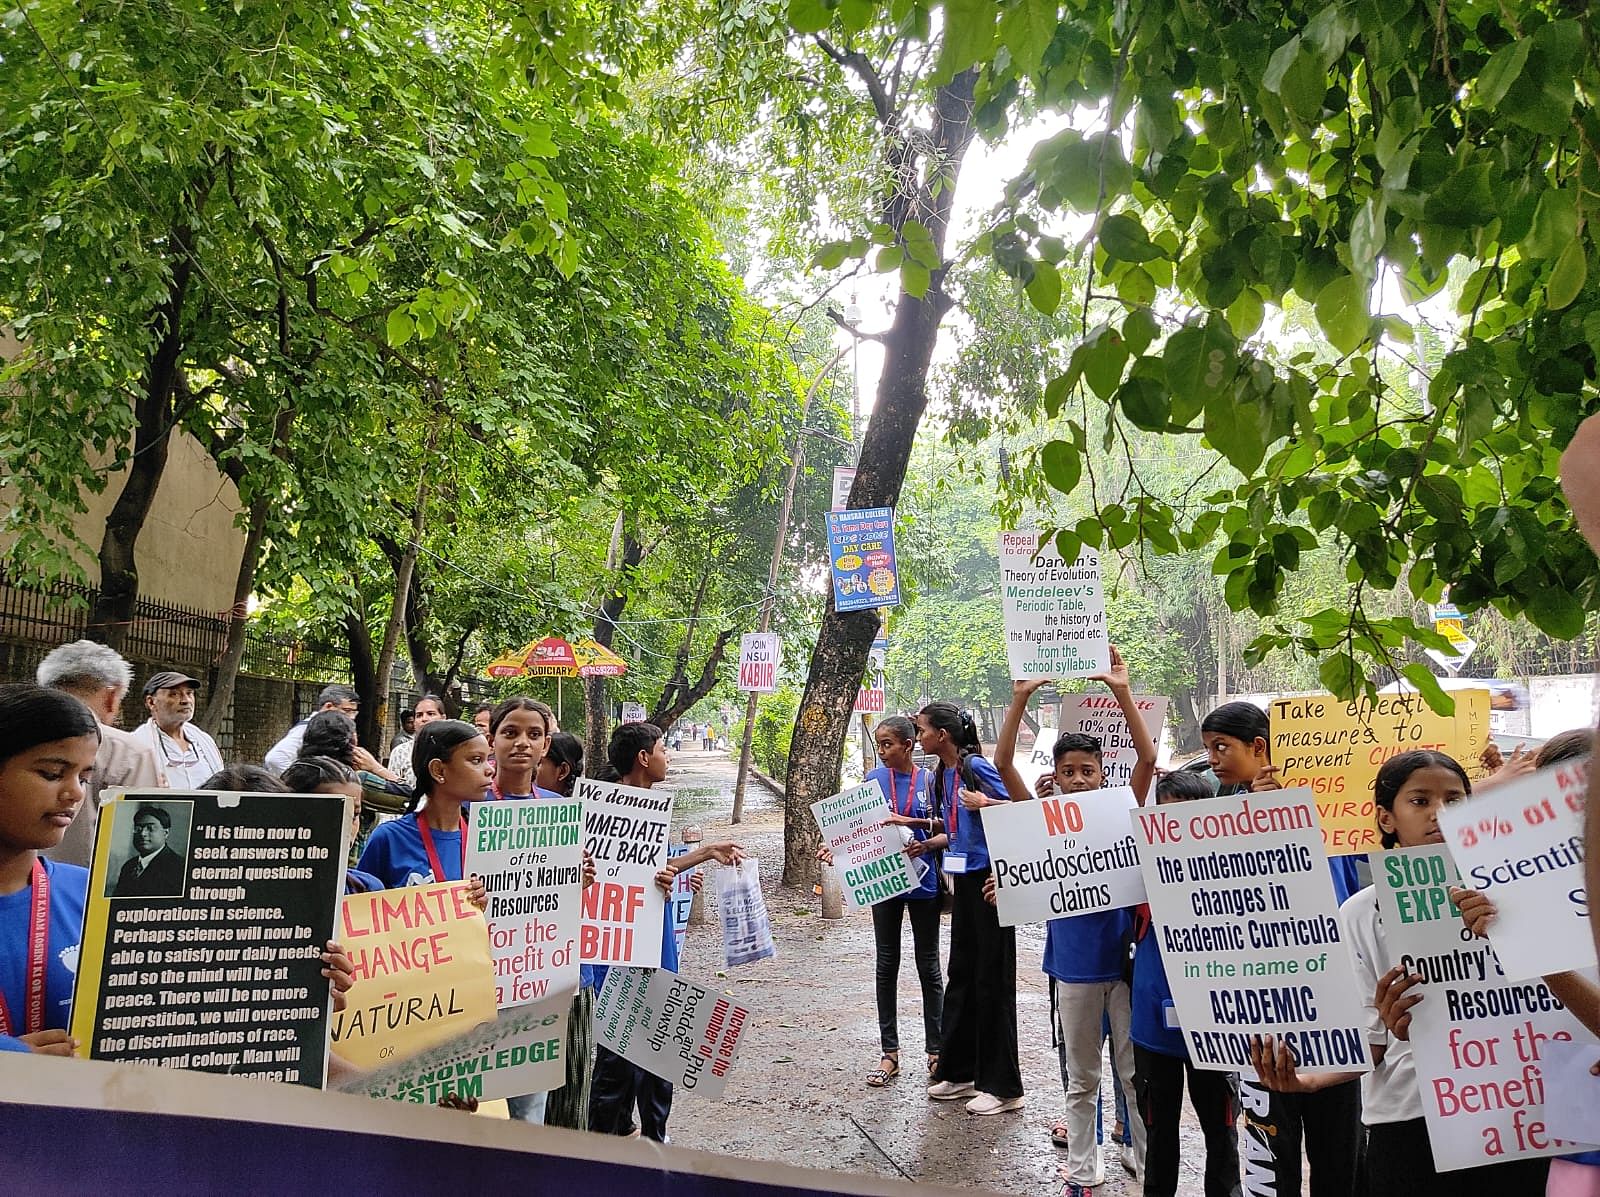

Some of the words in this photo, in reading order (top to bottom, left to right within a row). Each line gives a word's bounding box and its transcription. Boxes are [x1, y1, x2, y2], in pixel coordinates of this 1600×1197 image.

[1003, 534, 1035, 548] Repeal
[1005, 570, 1036, 584] Theory
[1039, 570, 1048, 581] of
[1051, 568, 1099, 581] Evolution,
[1006, 584, 1094, 598] Mendeleev's
[1016, 600, 1054, 612] Periodic
[1057, 600, 1086, 612] Table,
[1045, 614, 1058, 626] the
[1060, 613, 1091, 629] history
[751, 640, 767, 650] JOIN
[1010, 630, 1023, 642] the
[1025, 629, 1054, 646] Mughal
[1057, 628, 1085, 641] Period
[746, 652, 770, 661] NSUI
[1037, 645, 1059, 658] from
[1062, 644, 1077, 657] the
[740, 663, 773, 687] KABIIR
[1023, 660, 1053, 673] school
[1055, 657, 1096, 675] syllabus
[1275, 700, 1324, 719] Take
[1078, 720, 1103, 732] 10%
[1275, 727, 1379, 748] measures
[1393, 719, 1422, 742] to
[1283, 748, 1353, 777] prevent
[579, 783, 602, 801] We
[605, 789, 671, 812] demand
[820, 793, 855, 813] Protect
[857, 786, 873, 800] the
[477, 806, 512, 829] Stop
[518, 801, 582, 828] rampant
[821, 796, 884, 828] Environment
[849, 817, 863, 828] and
[1042, 800, 1084, 836] NO
[1139, 813, 1182, 844] We
[1189, 803, 1314, 841] condemn
[218, 826, 231, 839] is
[234, 825, 265, 839] time
[267, 828, 296, 839] now
[297, 827, 311, 839] to
[477, 824, 579, 852] EXPLOITATION
[830, 833, 850, 848] take
[847, 840, 870, 854] steps
[873, 835, 882, 844] to
[1063, 838, 1075, 850] to
[194, 846, 228, 859] seek
[230, 847, 288, 859] answers
[291, 846, 305, 859] to
[307, 845, 328, 859] the
[510, 853, 524, 866] of
[527, 852, 547, 865] the
[616, 841, 660, 867] BACK
[851, 846, 886, 864] counter
[1157, 855, 1184, 884] the
[1187, 843, 1313, 881] undemocratic
[192, 866, 242, 880] eternal
[245, 867, 313, 881] questions
[537, 864, 581, 887] Natural
[607, 866, 621, 877] of
[845, 852, 906, 887] CLIMATE
[1384, 855, 1447, 888] Stop
[190, 886, 246, 901] through
[854, 872, 911, 905] CHANGE
[1050, 884, 1111, 914] claims
[1191, 885, 1266, 917] changes
[1273, 882, 1290, 910] in
[36, 899, 47, 930] KADAM
[116, 907, 208, 923] explorations
[210, 907, 224, 920] in
[226, 907, 285, 920] science.
[491, 893, 559, 918] Resources
[580, 882, 645, 924] NRF
[114, 929, 174, 944] Perhaps
[177, 928, 233, 941] science
[236, 926, 261, 940] will
[264, 928, 293, 939] now
[294, 926, 312, 938] be
[488, 923, 517, 949] for
[525, 918, 557, 944] the
[580, 924, 633, 962] Bill
[1163, 921, 1245, 953] Academic
[1248, 914, 1340, 949] Curricula
[34, 931, 45, 965] ROSHNI
[111, 950, 144, 965] able
[147, 950, 162, 963] to
[165, 948, 213, 964] satisfy
[215, 950, 238, 962] our
[242, 946, 277, 962] daily
[278, 945, 322, 960] needs,
[552, 940, 574, 968] of
[32, 966, 43, 977] KI
[108, 971, 137, 986] and
[140, 972, 158, 984] so
[161, 969, 185, 984] the
[187, 968, 223, 983] mind
[226, 967, 251, 981] will
[254, 966, 271, 980] be
[273, 966, 288, 980] at
[609, 968, 621, 987] 300
[1184, 961, 1201, 978] in
[1206, 960, 1237, 977] the
[1242, 957, 1299, 977] name
[1306, 953, 1327, 973] of
[31, 979, 42, 995] OR
[105, 993, 155, 1009] peace.
[159, 990, 200, 1005] There
[203, 989, 230, 1003] will
[231, 987, 250, 1002] be
[252, 988, 270, 1001] no
[272, 987, 308, 1000] more
[512, 975, 549, 1001] few
[616, 975, 633, 1010] abolish
[330, 988, 463, 1042] NATURAL
[596, 986, 613, 1020] awards
[647, 979, 688, 1052] Fellowship
[673, 986, 706, 1045] Postdoc
[1210, 985, 1317, 1025] ACADEMIC
[102, 1011, 198, 1031] superstition,
[200, 1012, 221, 1024] we
[224, 1008, 250, 1023] will
[252, 1006, 320, 1022] overcome
[603, 1011, 620, 1041] nearly
[641, 1006, 653, 1030] and
[704, 999, 730, 1045] number
[100, 1037, 126, 1053] the
[128, 1030, 244, 1050] discriminations
[247, 1029, 262, 1042] of
[263, 1028, 298, 1042] race,
[617, 1014, 638, 1054] decision
[719, 1006, 750, 1057] Increase
[161, 1054, 188, 1069] and
[191, 1051, 240, 1067] colour.
[243, 1048, 273, 1063] Man
[275, 1047, 301, 1061] will
[379, 1046, 394, 1058] OR
[679, 1036, 693, 1061] and
[698, 1044, 713, 1059] of
[1449, 1029, 1500, 1070] for
[285, 1068, 299, 1082] in
[682, 1054, 705, 1089] PhD
[711, 1058, 731, 1077] the
[1482, 1127, 1505, 1156] a
